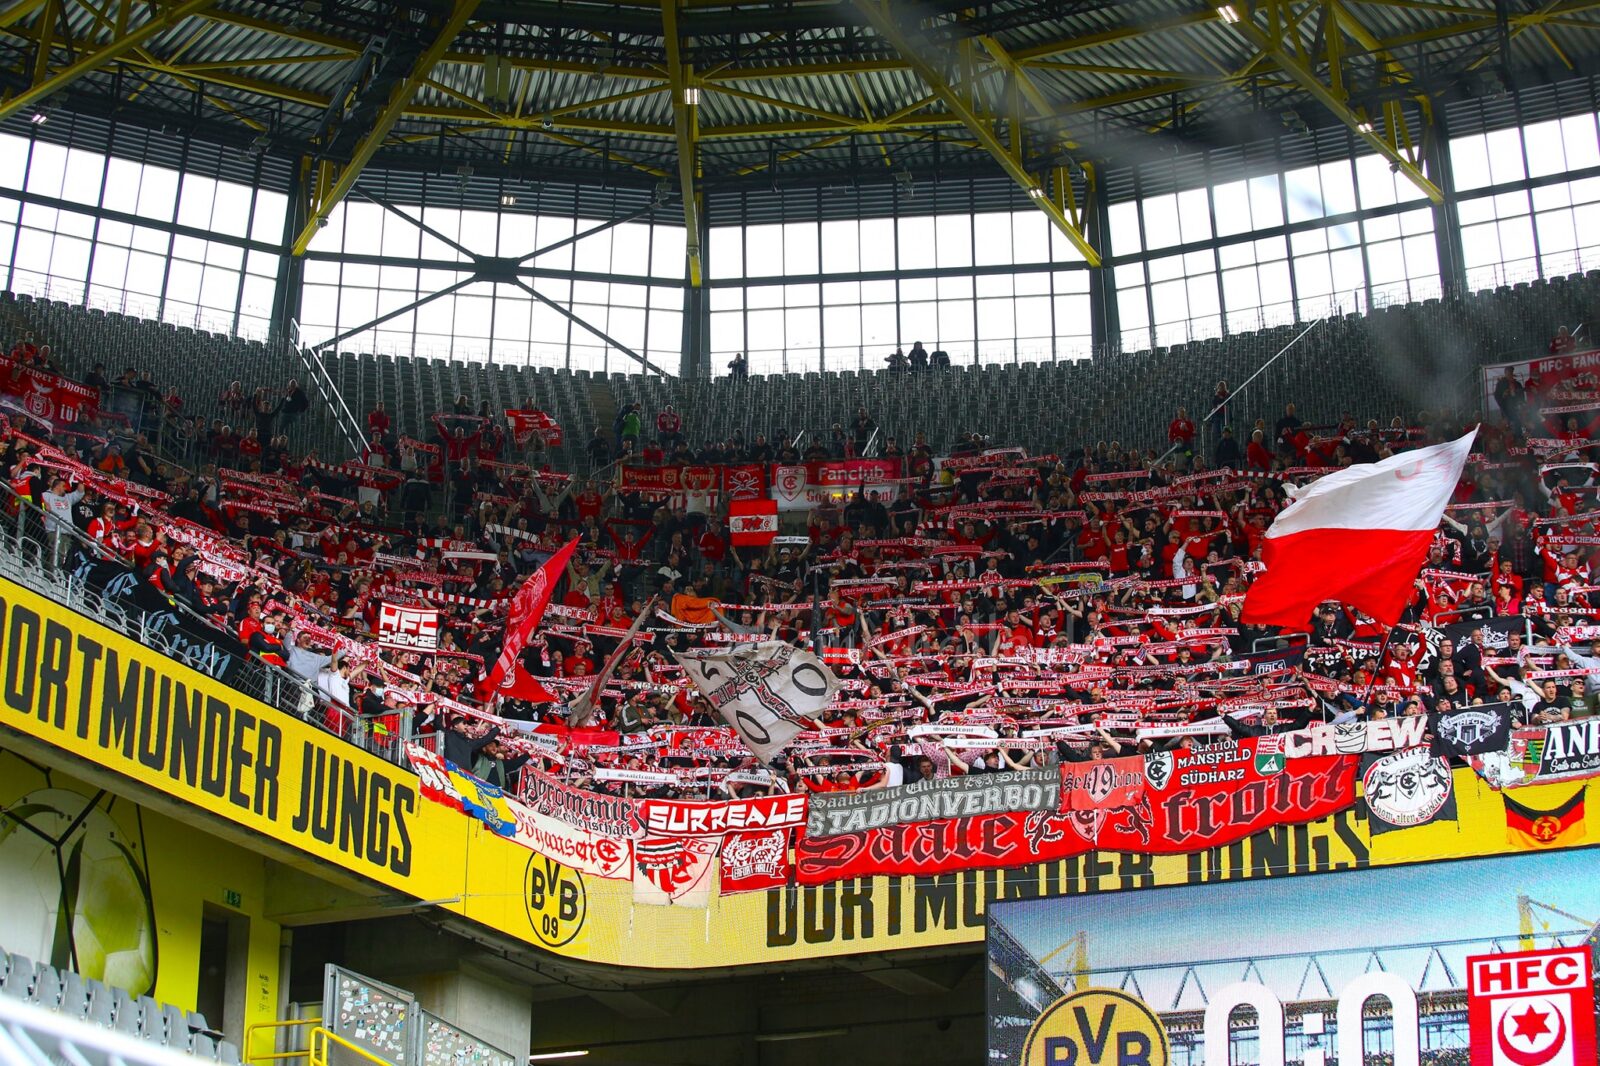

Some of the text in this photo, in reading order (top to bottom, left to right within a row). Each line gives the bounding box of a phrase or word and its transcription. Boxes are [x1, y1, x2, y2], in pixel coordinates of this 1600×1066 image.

[1540, 359, 1563, 373] HFC
[818, 465, 885, 481] Fanclub
[1548, 536, 1564, 544] HFC
[379, 606, 438, 637] HFC
[378, 629, 437, 648] CHEMIE
[0, 597, 283, 823] ORTMUNDER
[1177, 749, 1252, 770] MANSFELD
[1190, 739, 1239, 755] SEKTION
[1180, 768, 1246, 787] SÜDHARZ
[292, 741, 415, 878] JUNGS
[524, 773, 633, 823] Pyromanie
[806, 782, 1061, 838] STADIONVERBOT
[649, 798, 805, 832] SURREALE
[797, 757, 1352, 877] Saale front
[531, 857, 579, 922] BVB
[542, 913, 559, 939] 09
[1478, 955, 1582, 995] HFC
